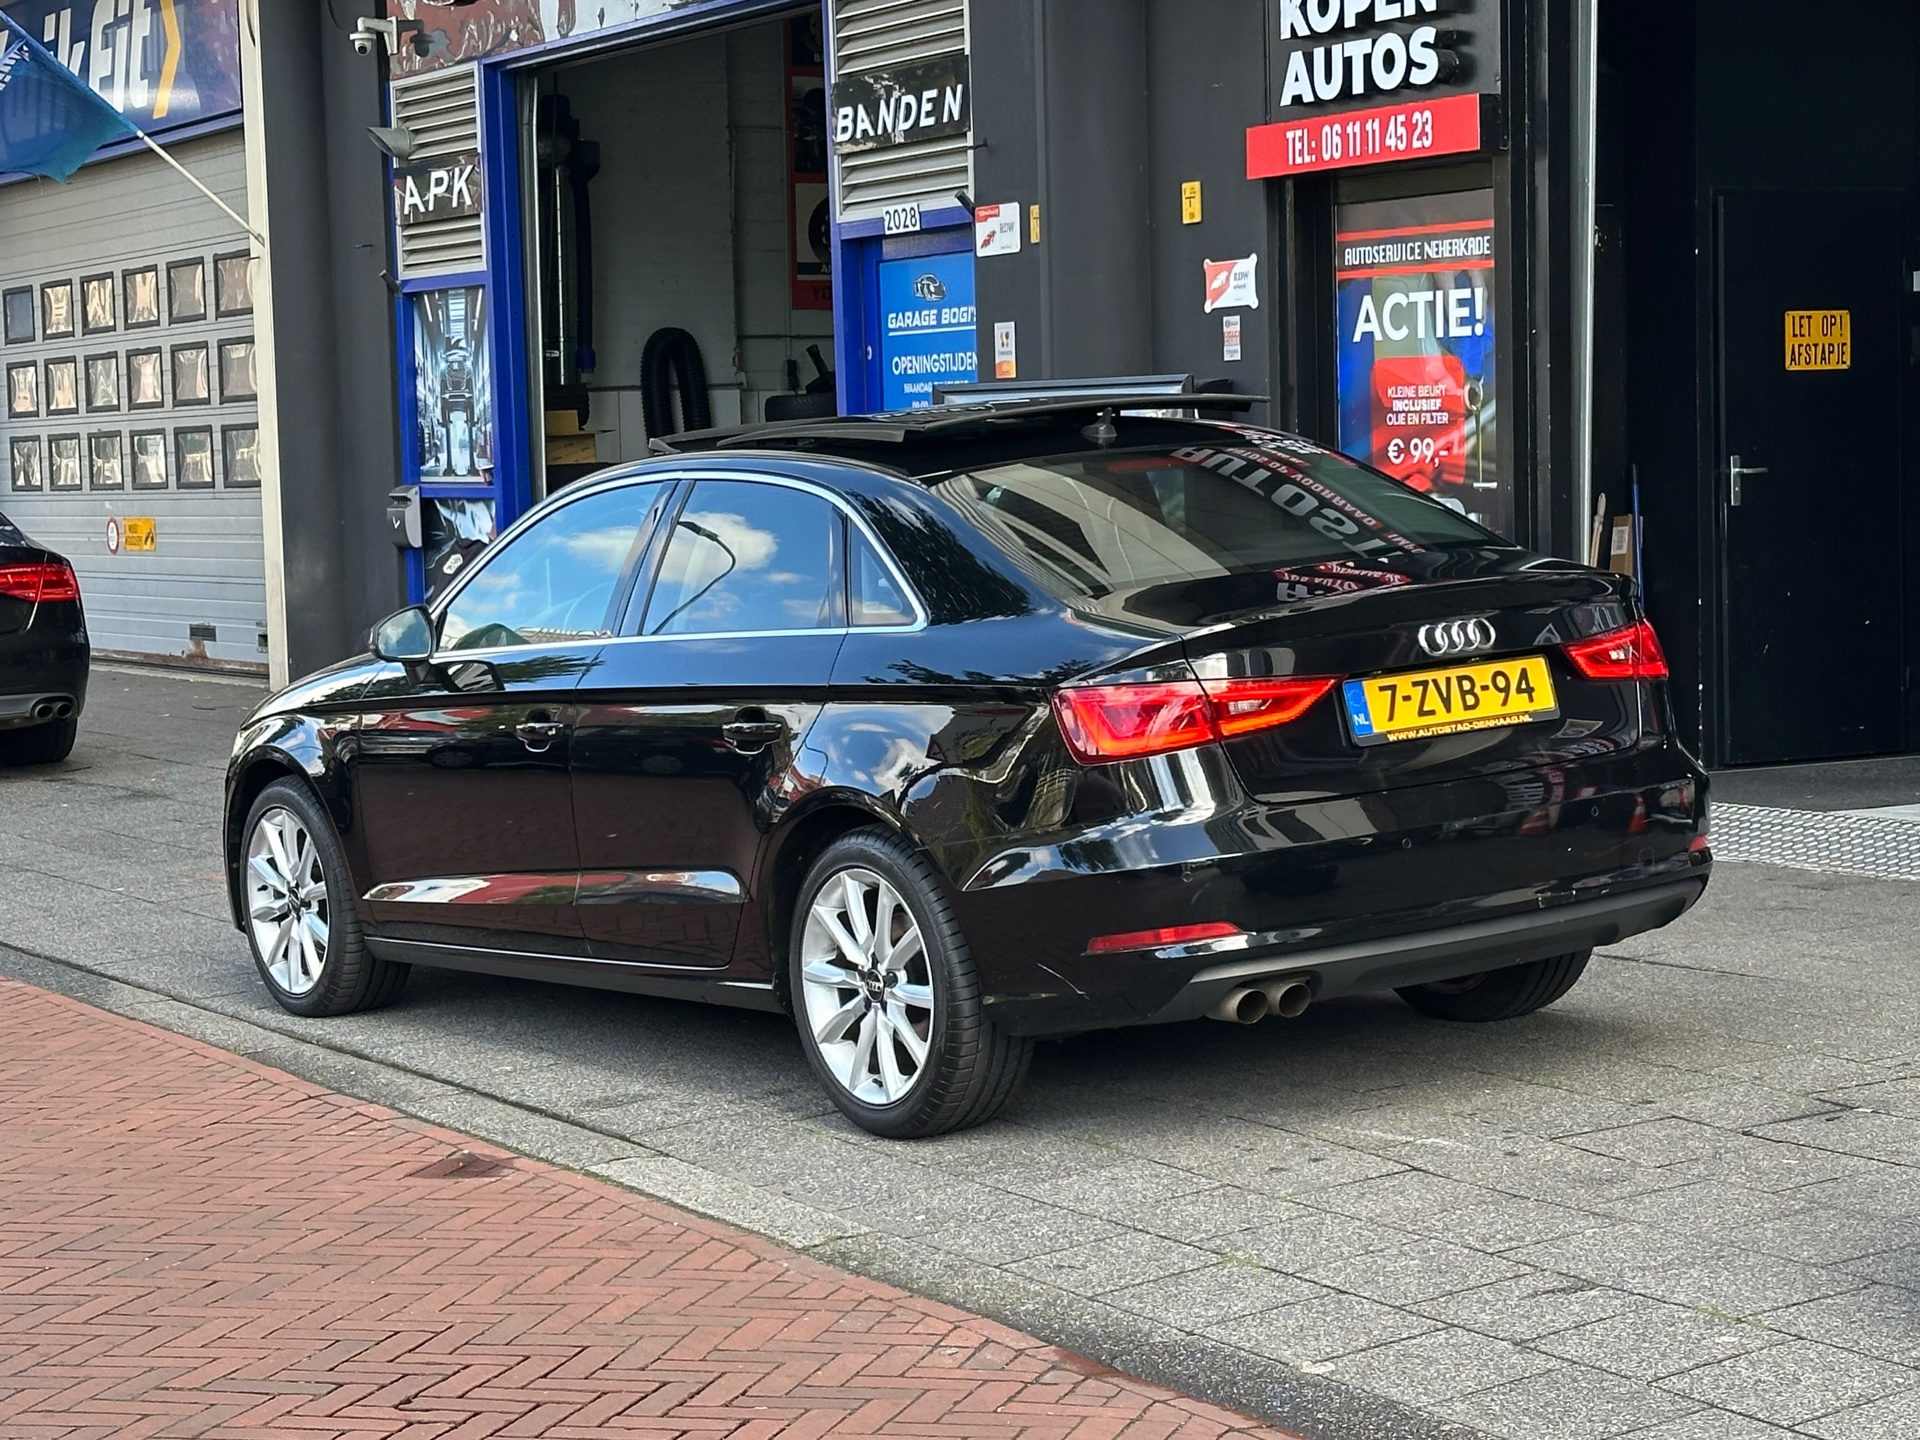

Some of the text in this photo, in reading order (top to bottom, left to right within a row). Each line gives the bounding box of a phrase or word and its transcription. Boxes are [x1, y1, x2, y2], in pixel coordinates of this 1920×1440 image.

[1280, 0, 1437, 40] KOP
[1280, 26, 1439, 107] AUTOS
[835, 83, 965, 143] BANDEN
[1286, 110, 1433, 166] TEL: 06 11 11 45 23
[403, 164, 474, 214] APK
[885, 207, 917, 231] 2028
[1424, 236, 1491, 259] NEHERKADE
[888, 309, 937, 328] GARAGE
[1353, 288, 1484, 342] ACTIE!
[1791, 314, 1843, 338] LET OP!
[1789, 341, 1847, 366] AFSTAPJE
[1387, 385, 1447, 398] KLEINE BEURT
[1392, 399, 1442, 411] INCLUSIEF
[1386, 412, 1449, 426] OLIE EN FILTER
[1387, 438, 1449, 467] € 99,-
[1378, 667, 1536, 722] 7-ZVB-94
[1353, 714, 1369, 726] NL
